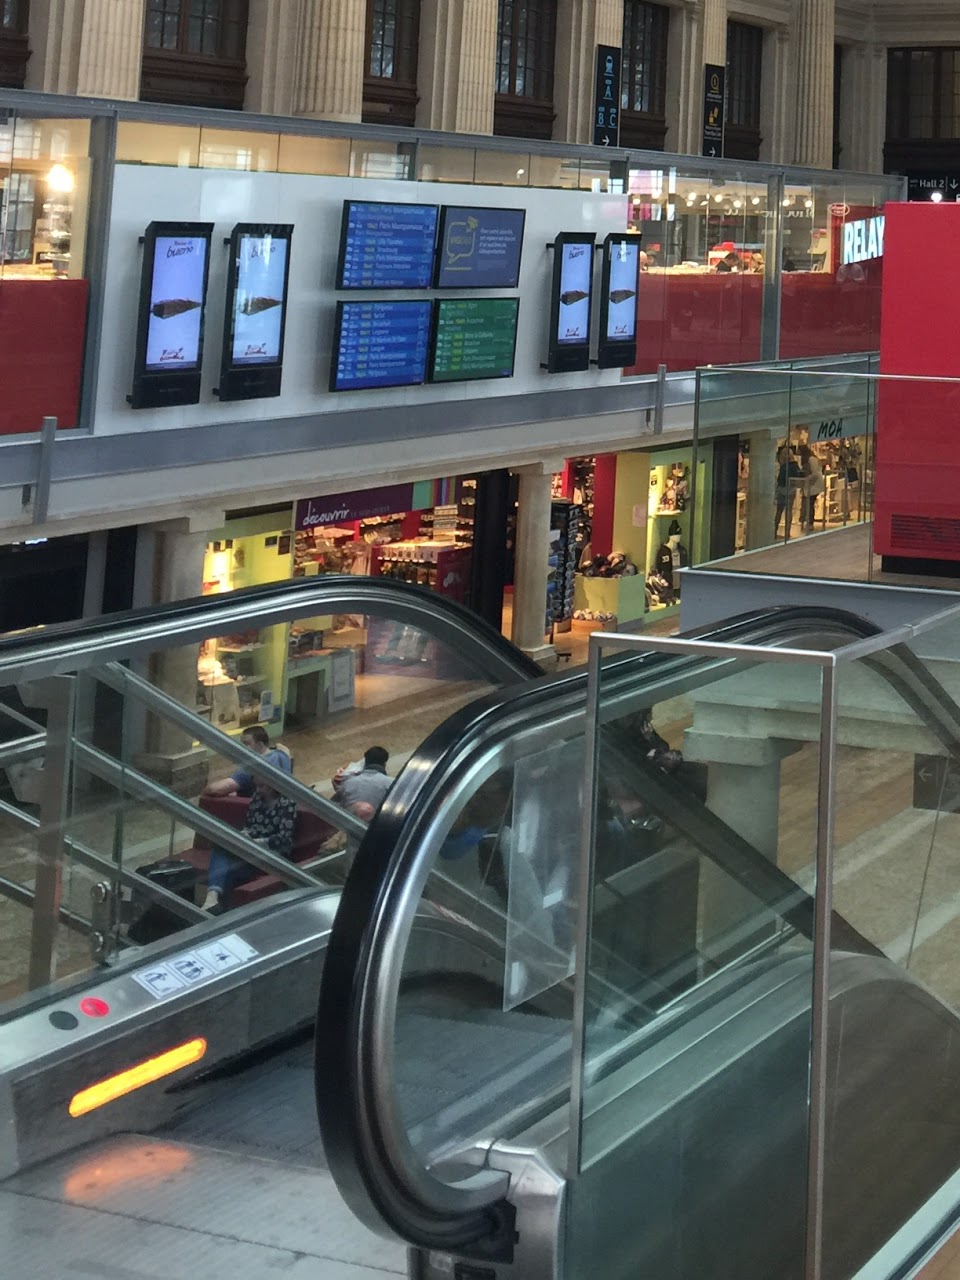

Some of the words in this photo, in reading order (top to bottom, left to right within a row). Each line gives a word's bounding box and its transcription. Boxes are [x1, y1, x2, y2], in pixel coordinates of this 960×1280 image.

[605, 86, 612, 97] A
[599, 113, 605, 124] B
[609, 114, 616, 126] C
[919, 179, 937, 188] Hall
[938, 179, 945, 188] 2
[844, 216, 885, 264] RELAY
[166, 245, 194, 258] bueno
[817, 418, 843, 439] MOA
[303, 501, 350, 526] découvrir
